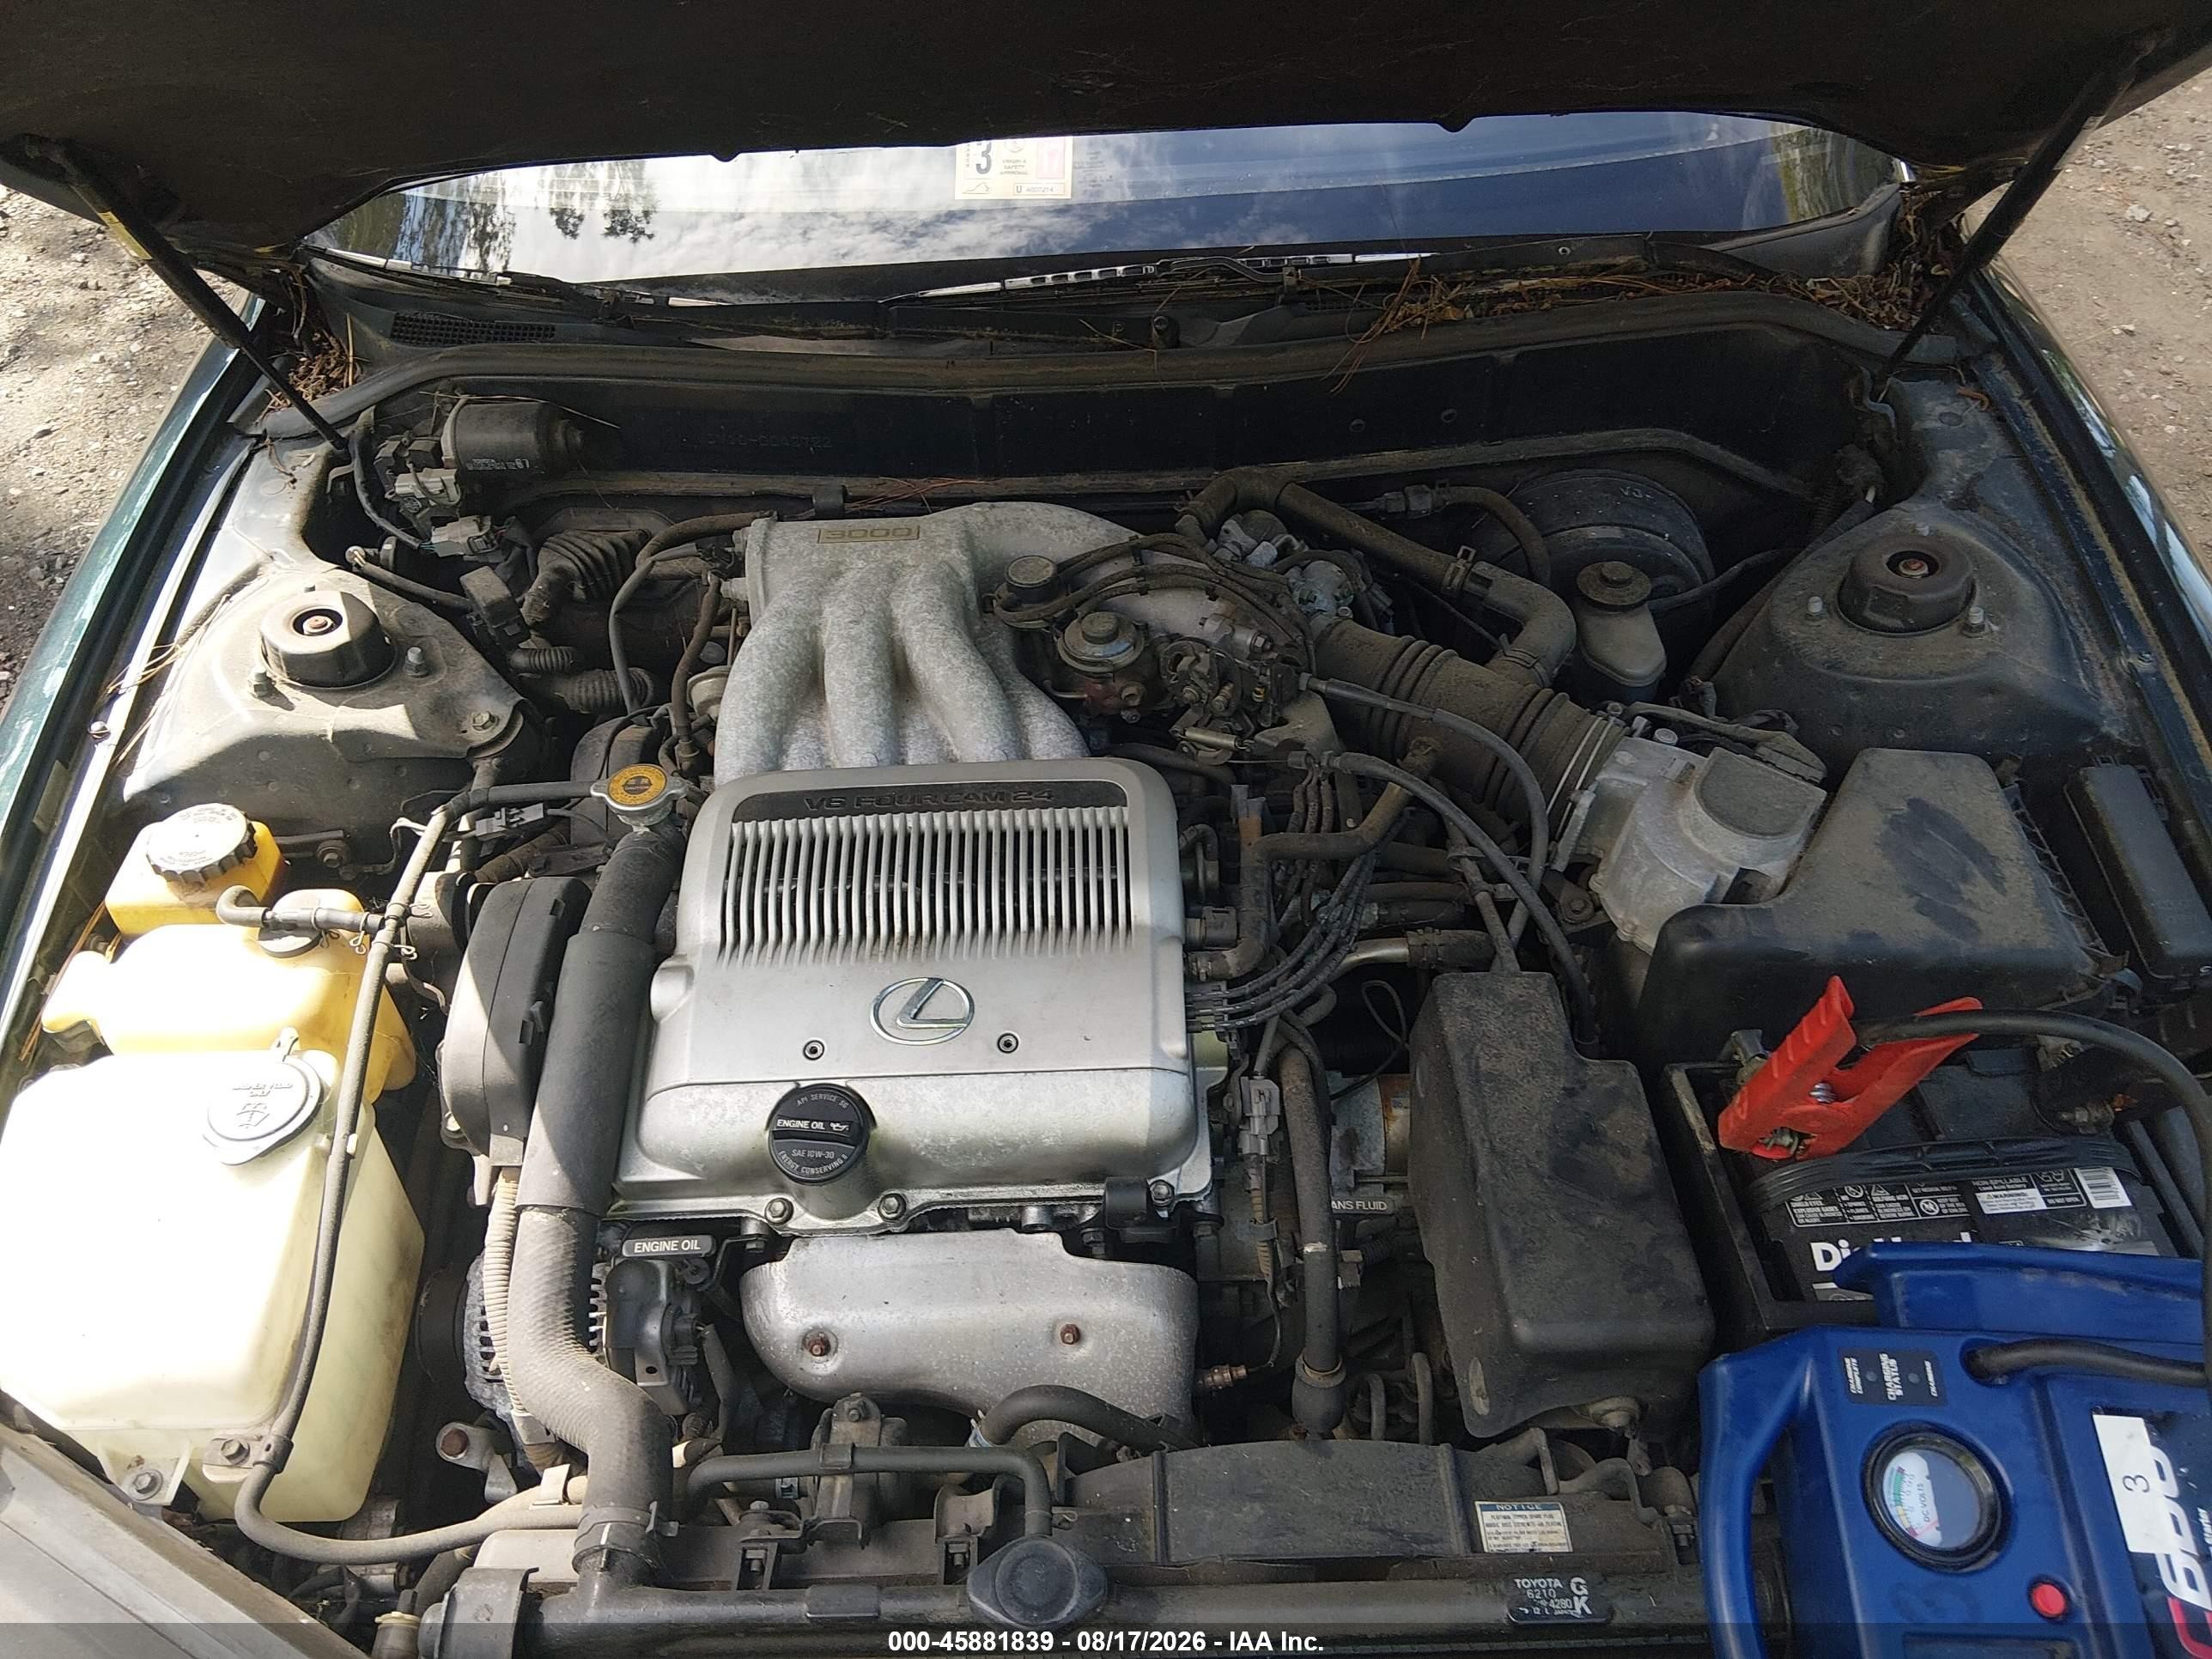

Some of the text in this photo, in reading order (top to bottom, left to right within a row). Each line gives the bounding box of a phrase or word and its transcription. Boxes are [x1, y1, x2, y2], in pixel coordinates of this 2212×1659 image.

[975, 141, 992, 174] 3
[1017, 185, 1022, 193] U
[825, 527, 913, 539] 3000
[803, 788, 1055, 811] V6 FOUR CAM 24
[810, 1093, 838, 1103] SERVICE
[776, 1119, 825, 1130] ENGINE OIL
[791, 1148, 836, 1159] SAE 10W-30
[778, 1150, 800, 1170] ENERGY
[800, 1158, 845, 1175] CONSERVING
[1331, 1200, 1388, 1211] ANS FLUID
[634, 1239, 701, 1253] ENGINE OIL
[1879, 1352, 1897, 1401] CHARGING
[1888, 1358, 1904, 1396] STATUS
[2122, 1474, 2150, 1493] 3
[1922, 1510, 1930, 1522] DC
[1514, 1577, 1564, 1589] TOYOTA
[1570, 1577, 1589, 1595] G
[1526, 1589, 1557, 1599] 6210
[1572, 1595, 1592, 1615] K
